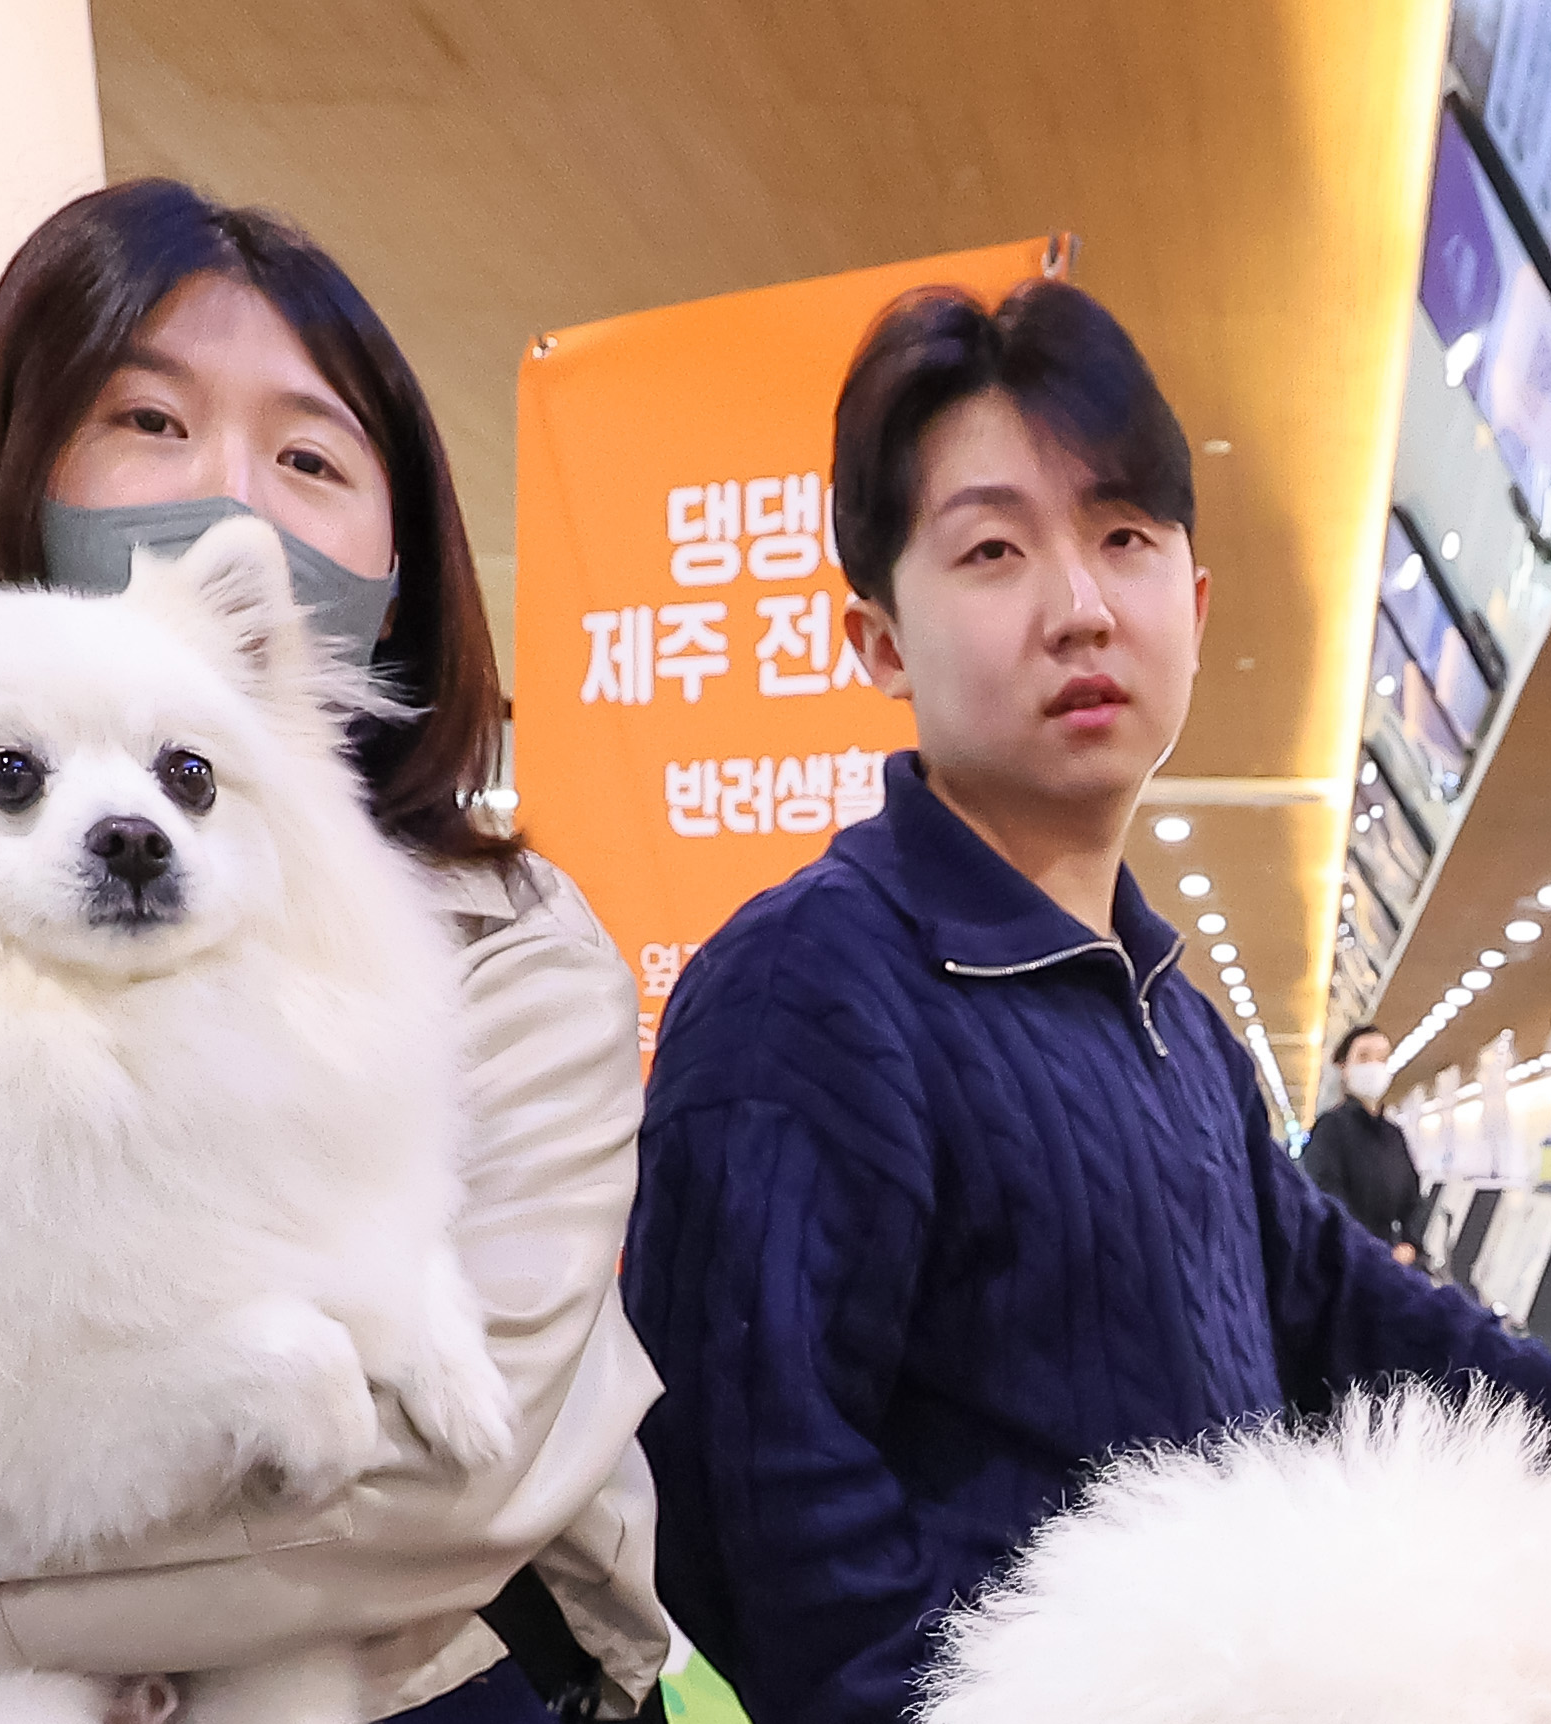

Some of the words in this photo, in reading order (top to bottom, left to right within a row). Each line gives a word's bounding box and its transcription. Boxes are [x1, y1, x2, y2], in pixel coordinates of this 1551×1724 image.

[666, 471, 842, 587] 댕댕
[580, 600, 730, 706] 제주
[640, 942, 702, 997] 옆
